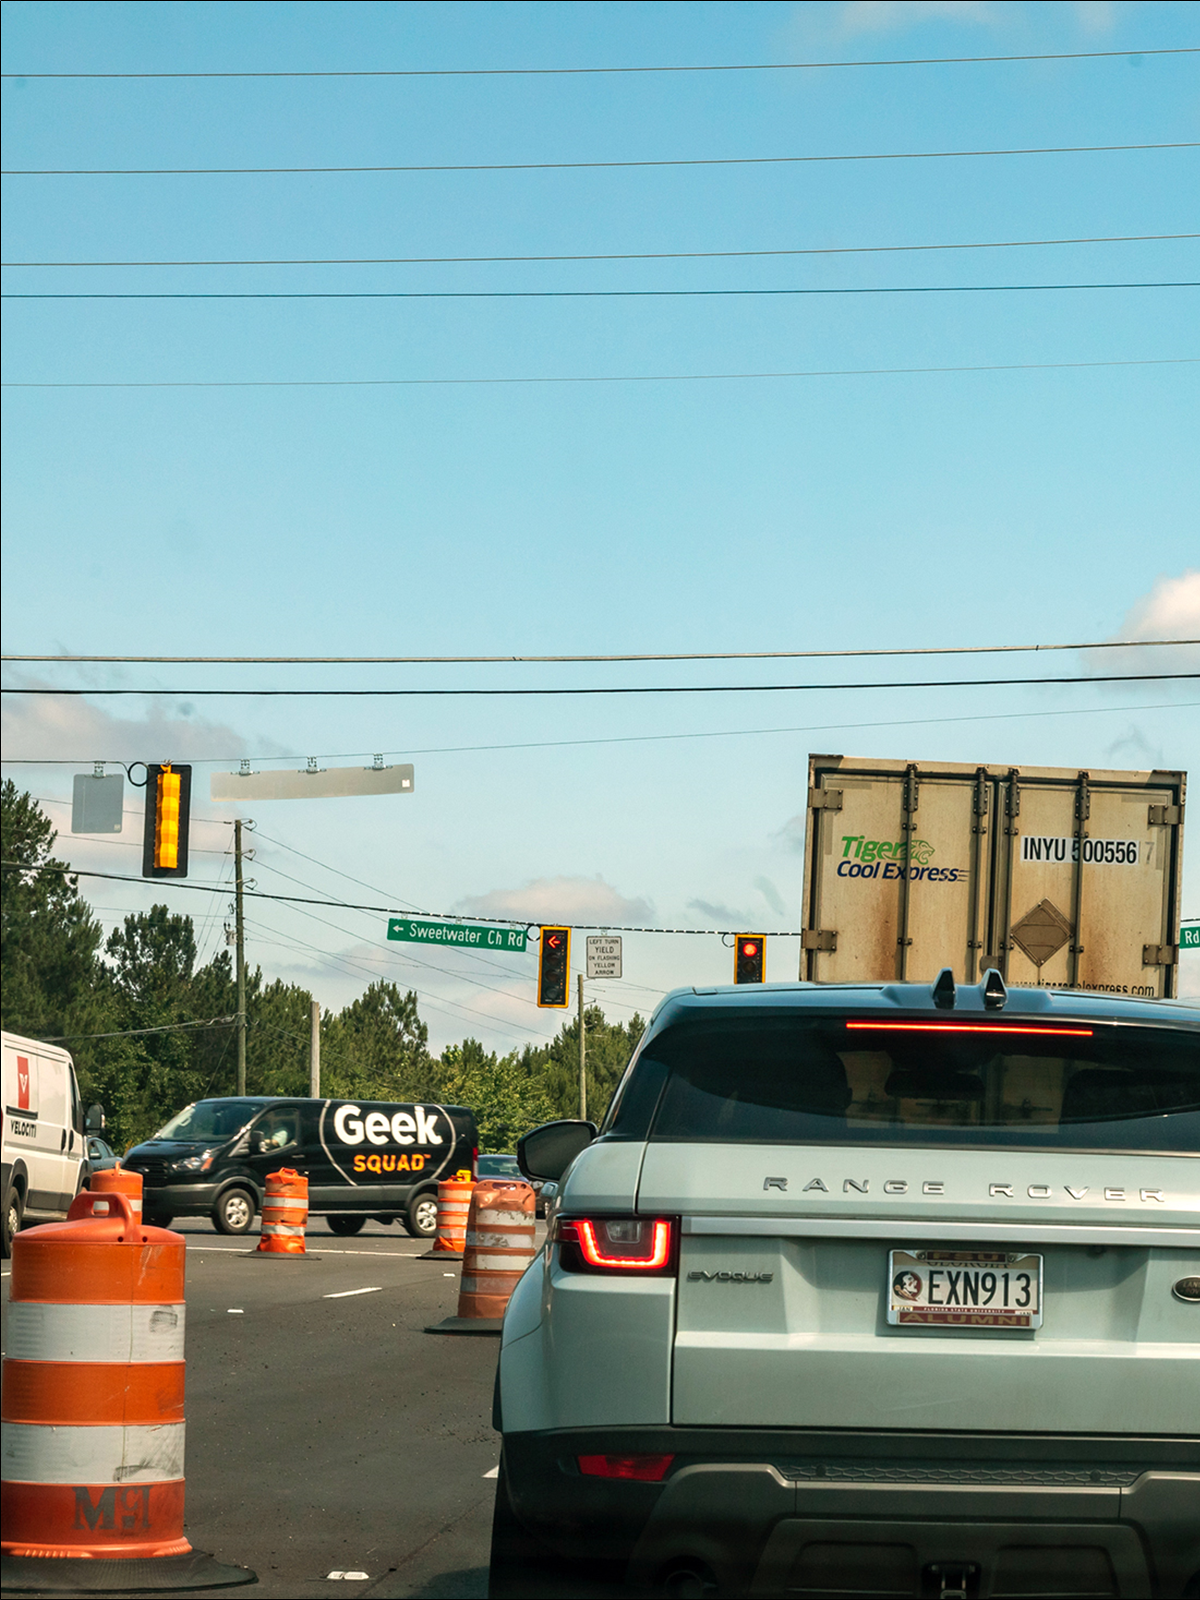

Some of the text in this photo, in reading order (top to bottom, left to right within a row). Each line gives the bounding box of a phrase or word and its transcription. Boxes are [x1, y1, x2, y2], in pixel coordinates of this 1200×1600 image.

[841, 835, 906, 862] Tiger
[1024, 837, 1155, 864] INYU 500556 7
[837, 861, 960, 882] Cool Express
[409, 923, 524, 947] Sweetwater Ch Rd
[1185, 930, 1200, 944] Rd
[595, 946, 615, 954] YIELD
[10, 1120, 37, 1138] VELOCITI
[334, 1104, 443, 1145] Geek
[353, 1153, 425, 1174] SQUAD
[763, 1177, 1165, 1202] RANGE ROVER
[688, 1270, 773, 1281] EVOQUE
[928, 1270, 1031, 1307] EXN913
[903, 1313, 1028, 1325] ALUMNI
